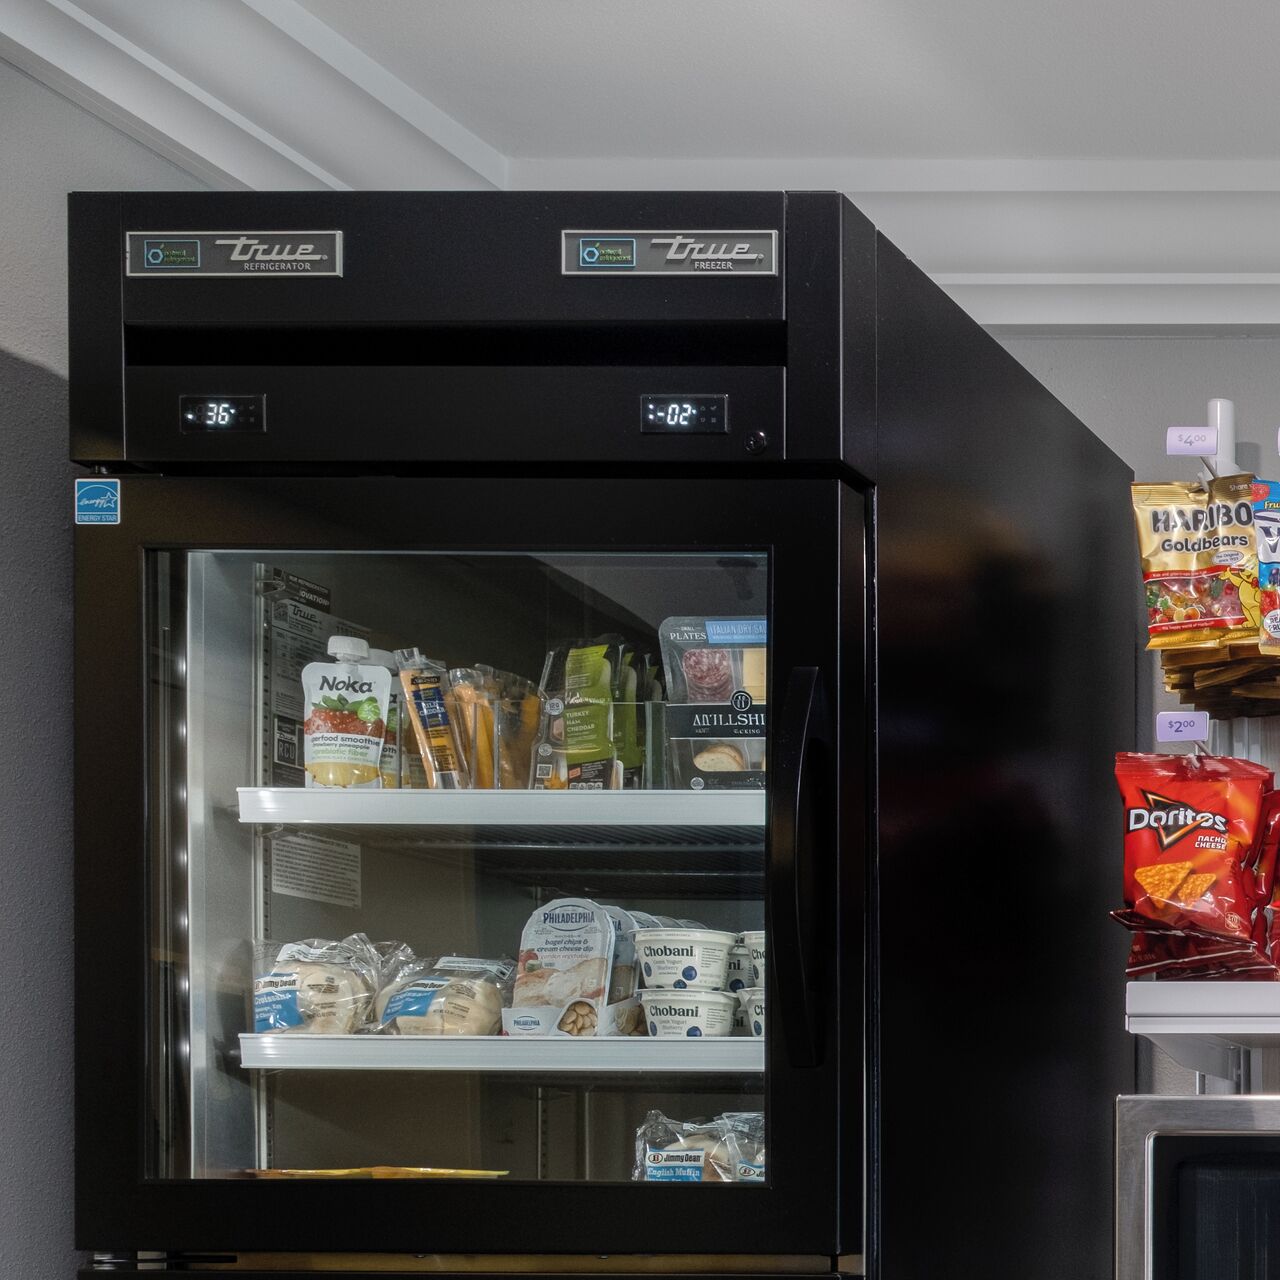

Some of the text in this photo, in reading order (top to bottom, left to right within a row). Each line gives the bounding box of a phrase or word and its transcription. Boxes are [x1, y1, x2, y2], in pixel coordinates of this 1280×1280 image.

[244, 262, 311, 270] REFRIGERATOR
[695, 261, 733, 270] FREEZER
[1151, 501, 1252, 532] HARIBO
[1161, 535, 1248, 552] Goldbears
[669, 632, 707, 641] PLATES
[319, 675, 373, 693] Noka
[1168, 720, 1195, 733] $200
[1129, 808, 1228, 831] Doritos
[1195, 842, 1227, 850] CHEESE
[543, 911, 595, 925] PHILADELPHIA
[643, 945, 695, 958] Chobani
[650, 1005, 700, 1017] Chobani
